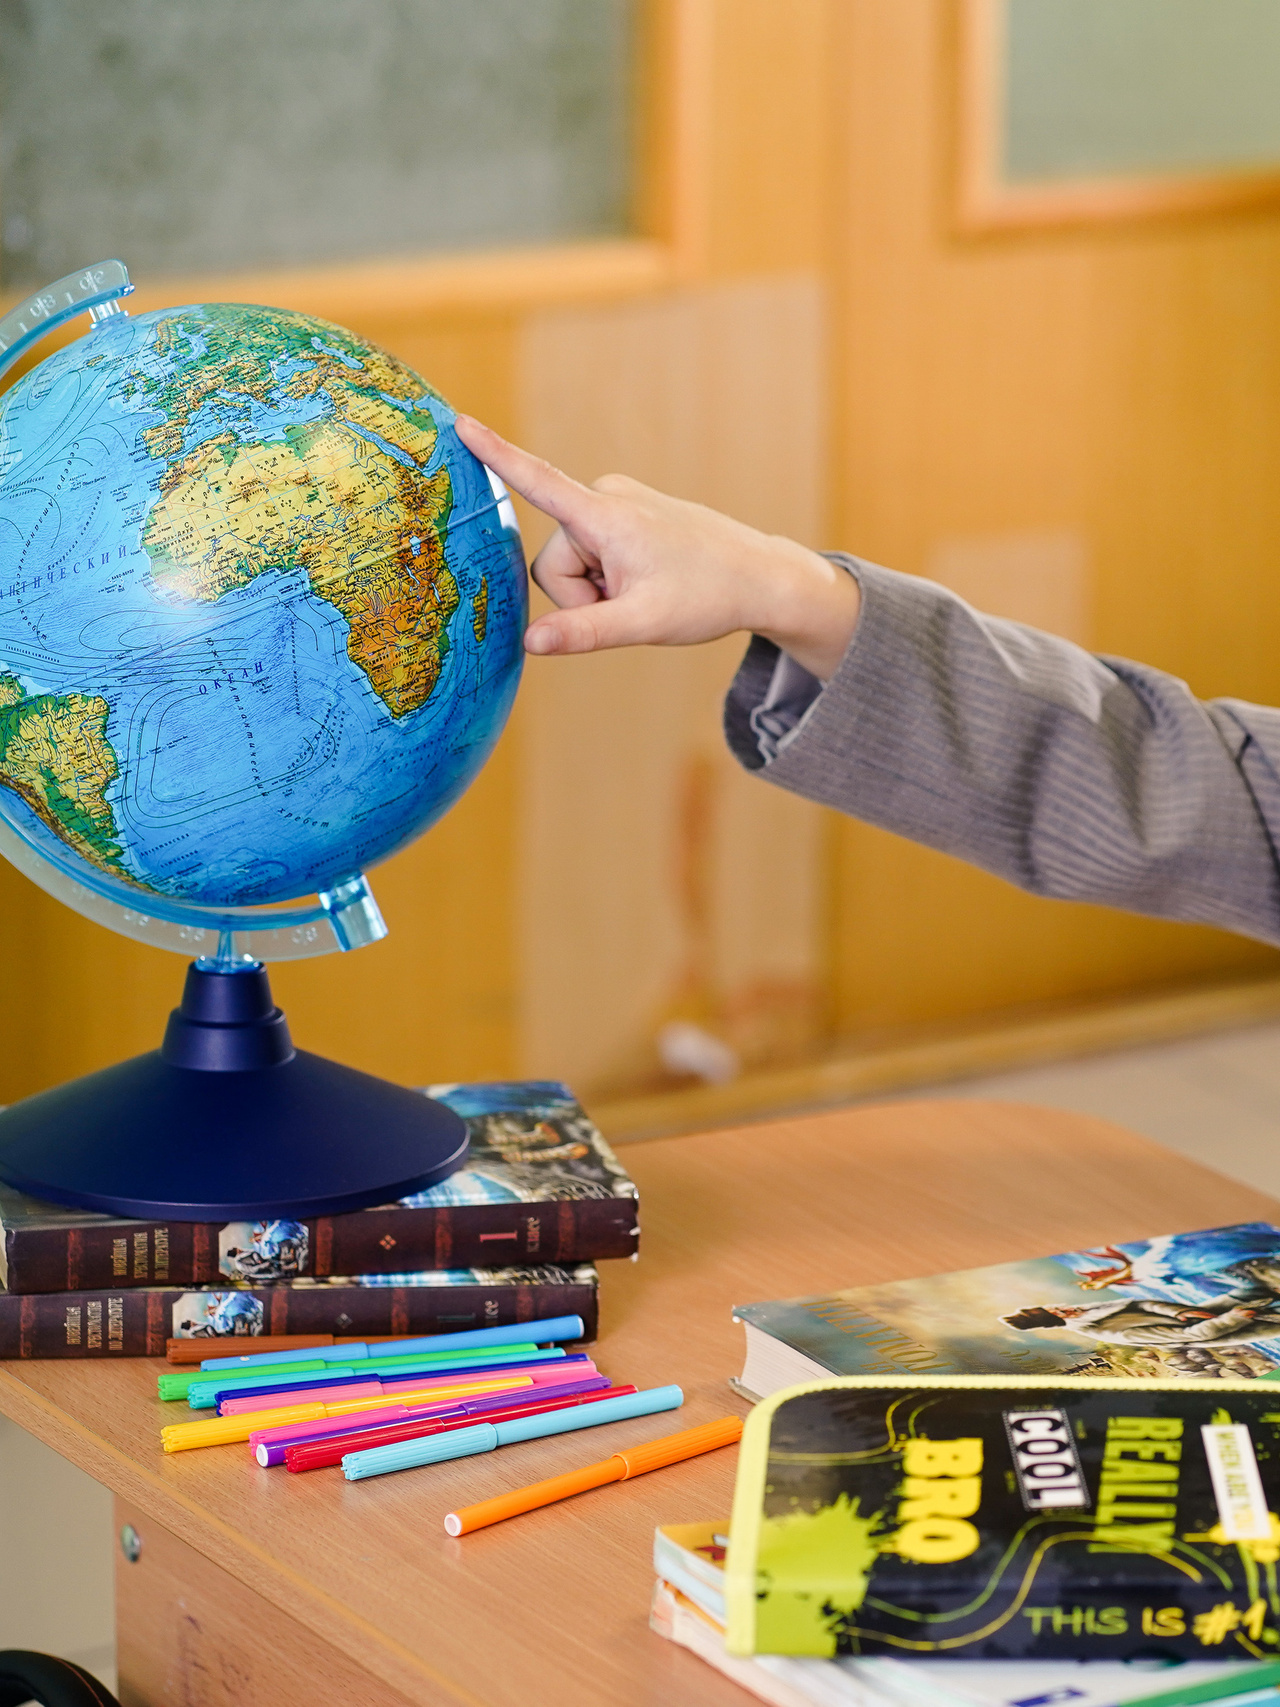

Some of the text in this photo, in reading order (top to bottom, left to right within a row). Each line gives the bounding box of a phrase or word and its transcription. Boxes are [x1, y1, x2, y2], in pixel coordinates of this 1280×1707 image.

[198, 661, 264, 695] ОКЕАН
[277, 808, 330, 829] хребет
[1009, 1415, 1078, 1501] COOL
[1214, 1430, 1245, 1470] WHEN
[894, 1436, 985, 1564] BRO
[1086, 1416, 1185, 1554] REALLY
[1226, 1473, 1250, 1499] ARE
[1022, 1606, 1128, 1637] THIS
[1142, 1606, 1187, 1637] IS
[1194, 1599, 1267, 1646] #1
